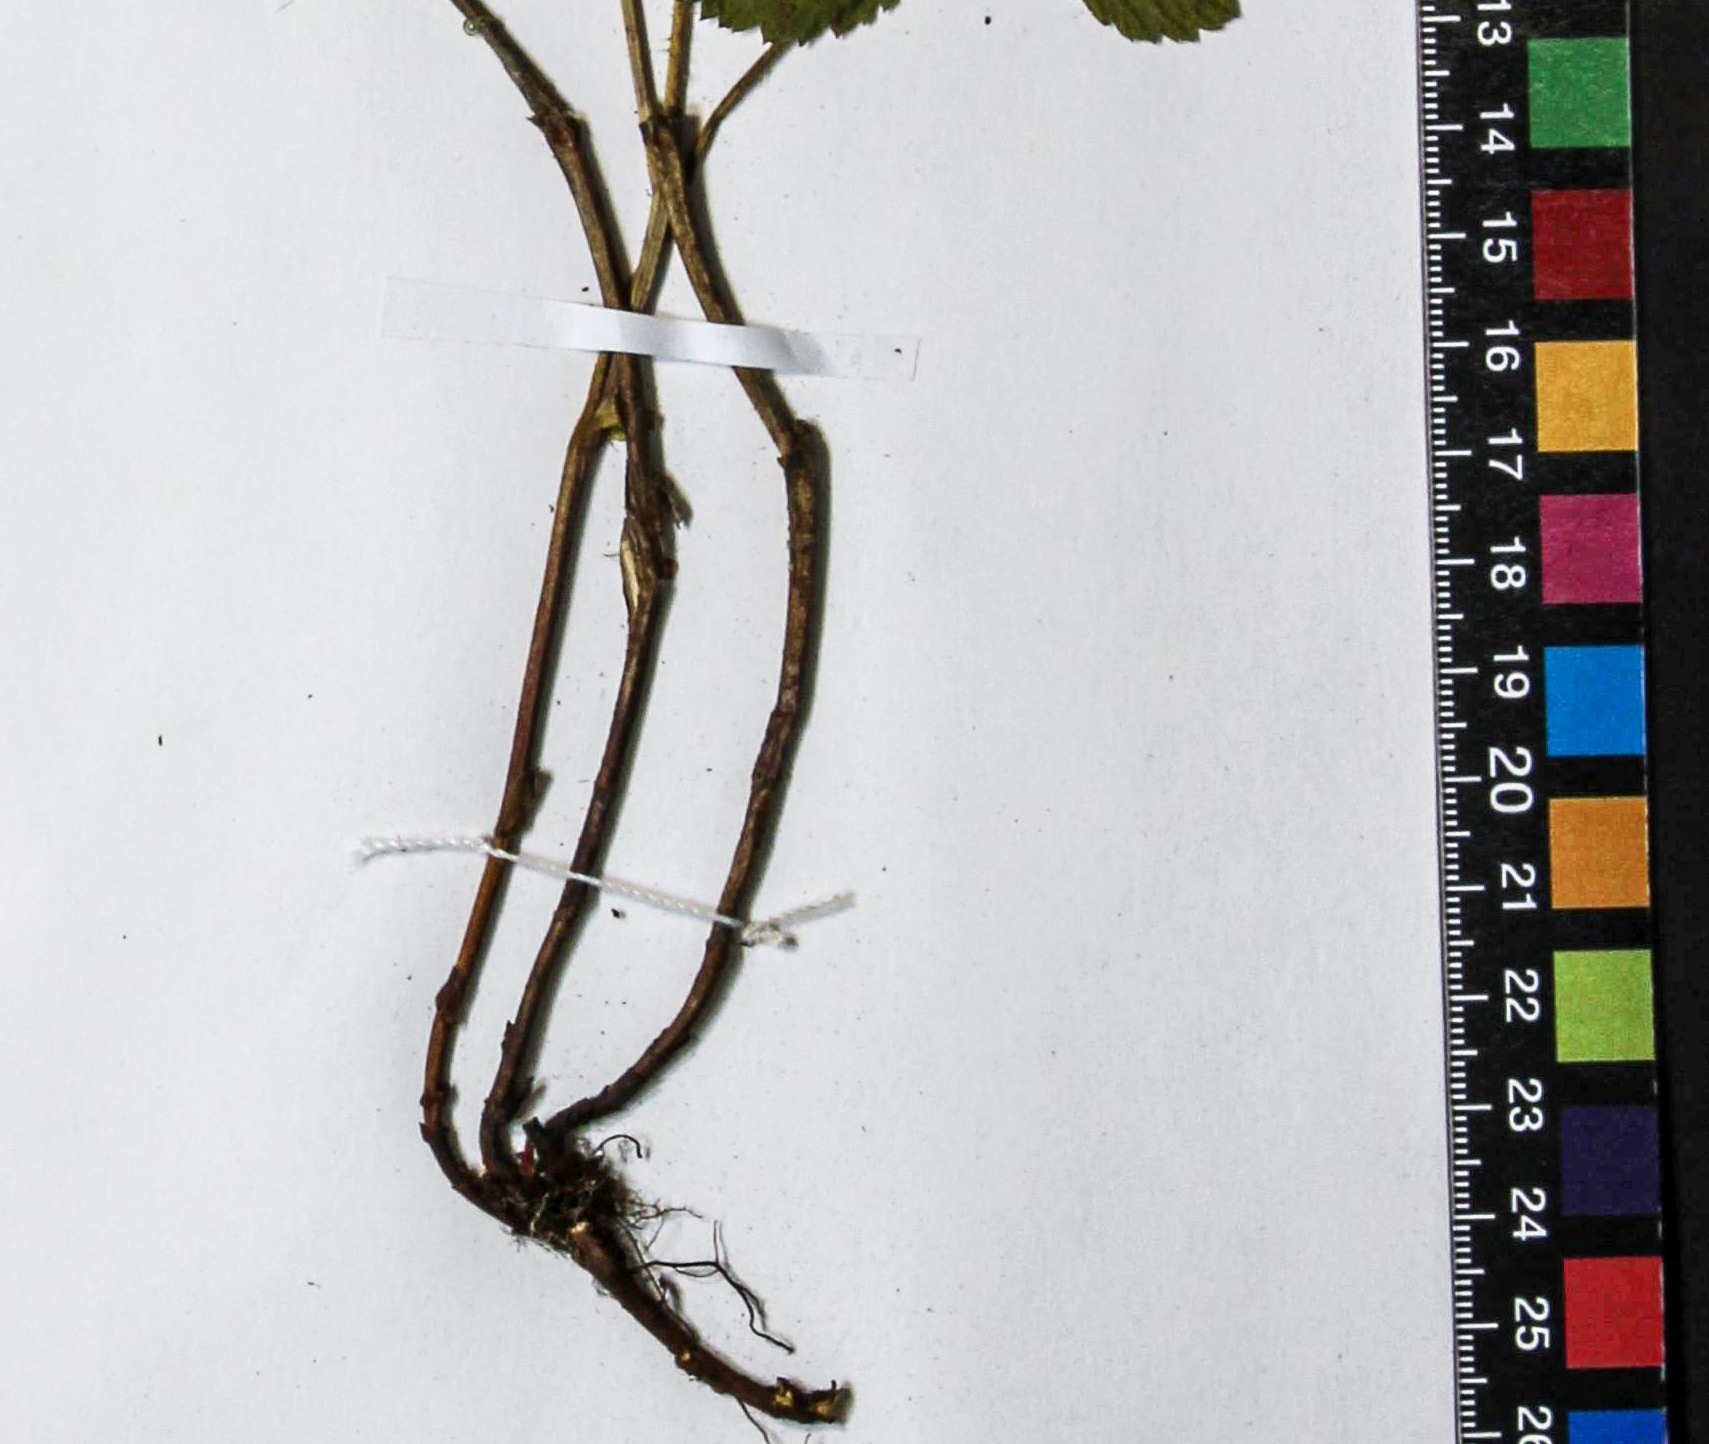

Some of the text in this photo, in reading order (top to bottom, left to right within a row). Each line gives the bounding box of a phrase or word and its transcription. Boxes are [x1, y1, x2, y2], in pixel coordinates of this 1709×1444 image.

[1480, 103, 1514, 154] 14
[1483, 212, 1517, 262] 15
[1486, 320, 1520, 371] 16
[1489, 429, 1523, 480] 17
[1490, 537, 1526, 589] 18
[1494, 646, 1529, 698] 19
[1489, 747, 1533, 813] 20
[1501, 864, 1536, 909] 21
[1505, 969, 1539, 1022] 22
[1508, 1079, 1543, 1131] 23
[1512, 1188, 1546, 1240] 24
[1515, 1297, 1549, 1350] 25
